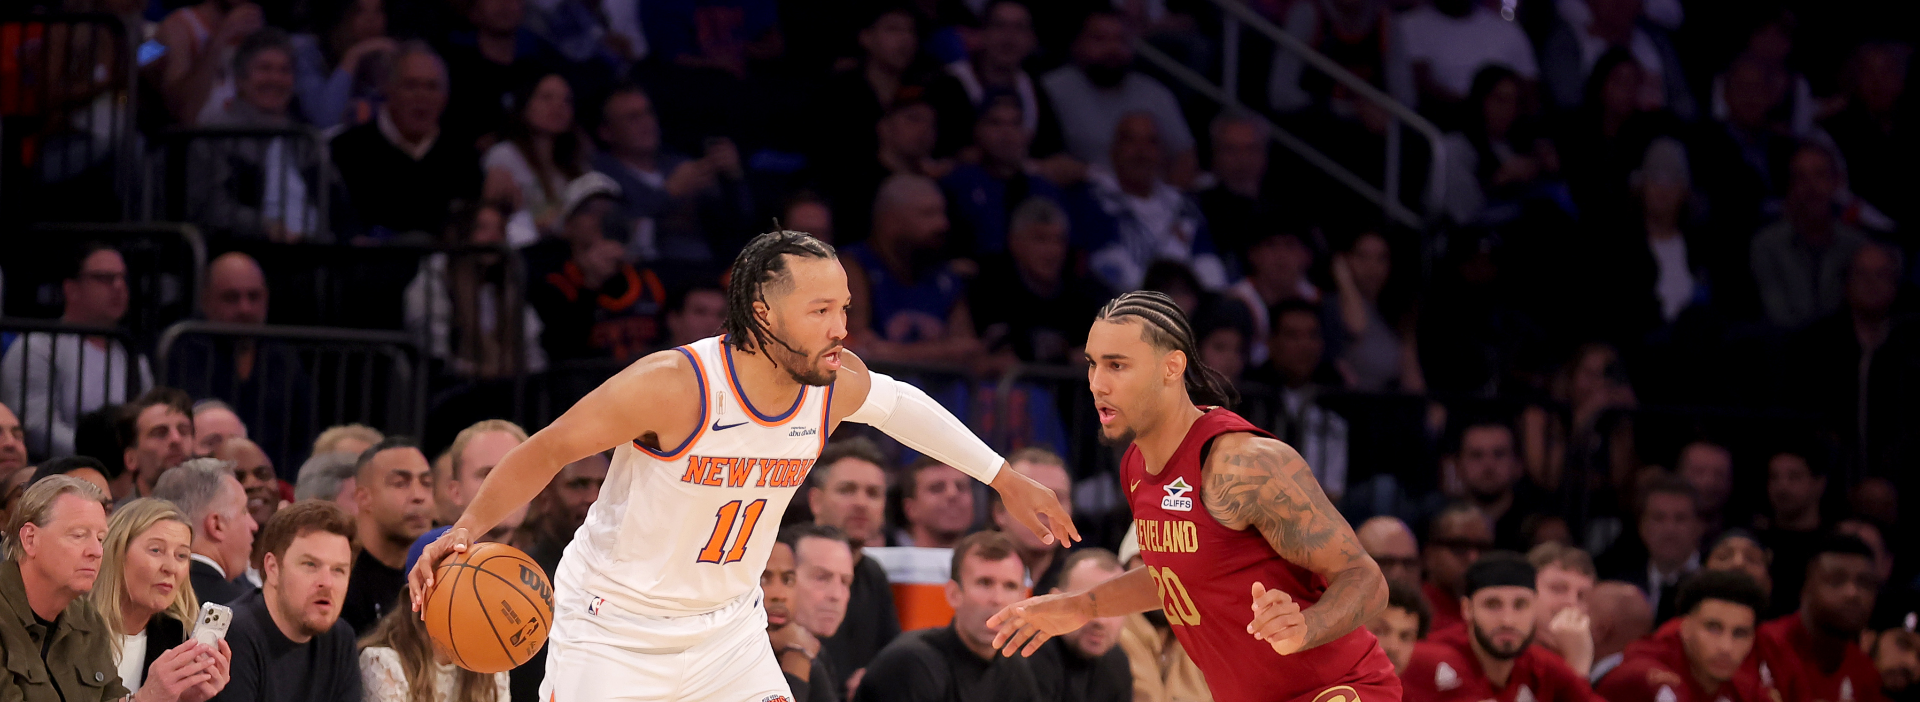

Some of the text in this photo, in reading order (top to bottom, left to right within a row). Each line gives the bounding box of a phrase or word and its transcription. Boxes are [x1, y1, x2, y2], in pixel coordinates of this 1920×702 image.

[681, 455, 814, 487] NEW YORK
[1163, 498, 1191, 509] CLIFFS
[696, 498, 767, 565] 11
[1134, 518, 1199, 553] LEVELAND
[1148, 565, 1201, 626] 20
